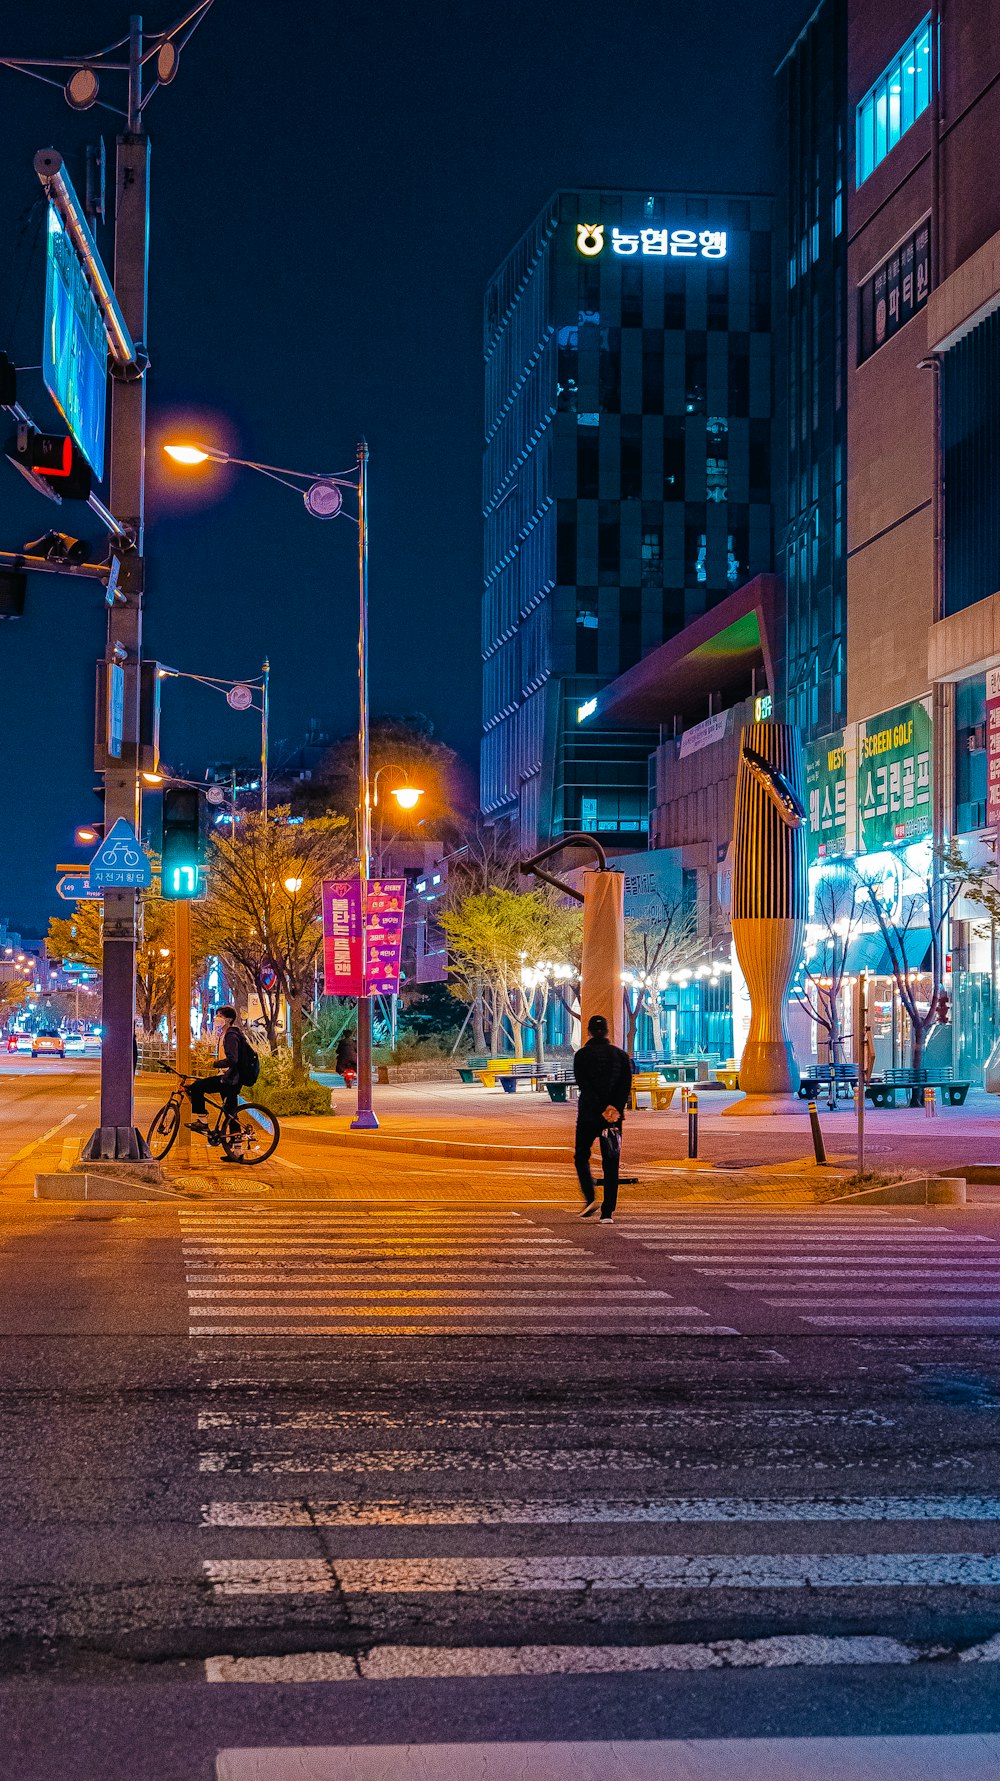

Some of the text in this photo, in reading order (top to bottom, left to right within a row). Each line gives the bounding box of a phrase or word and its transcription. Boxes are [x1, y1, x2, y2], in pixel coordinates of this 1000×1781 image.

[611, 228, 727, 258] 농협은행
[864, 720, 913, 758] SCREEN GOLF
[827, 747, 847, 771] WEST
[864, 751, 929, 820] 스크린골프
[809, 780, 846, 832] 웨스트
[95, 872, 145, 883] 자전거횡단
[173, 866, 194, 891] 17
